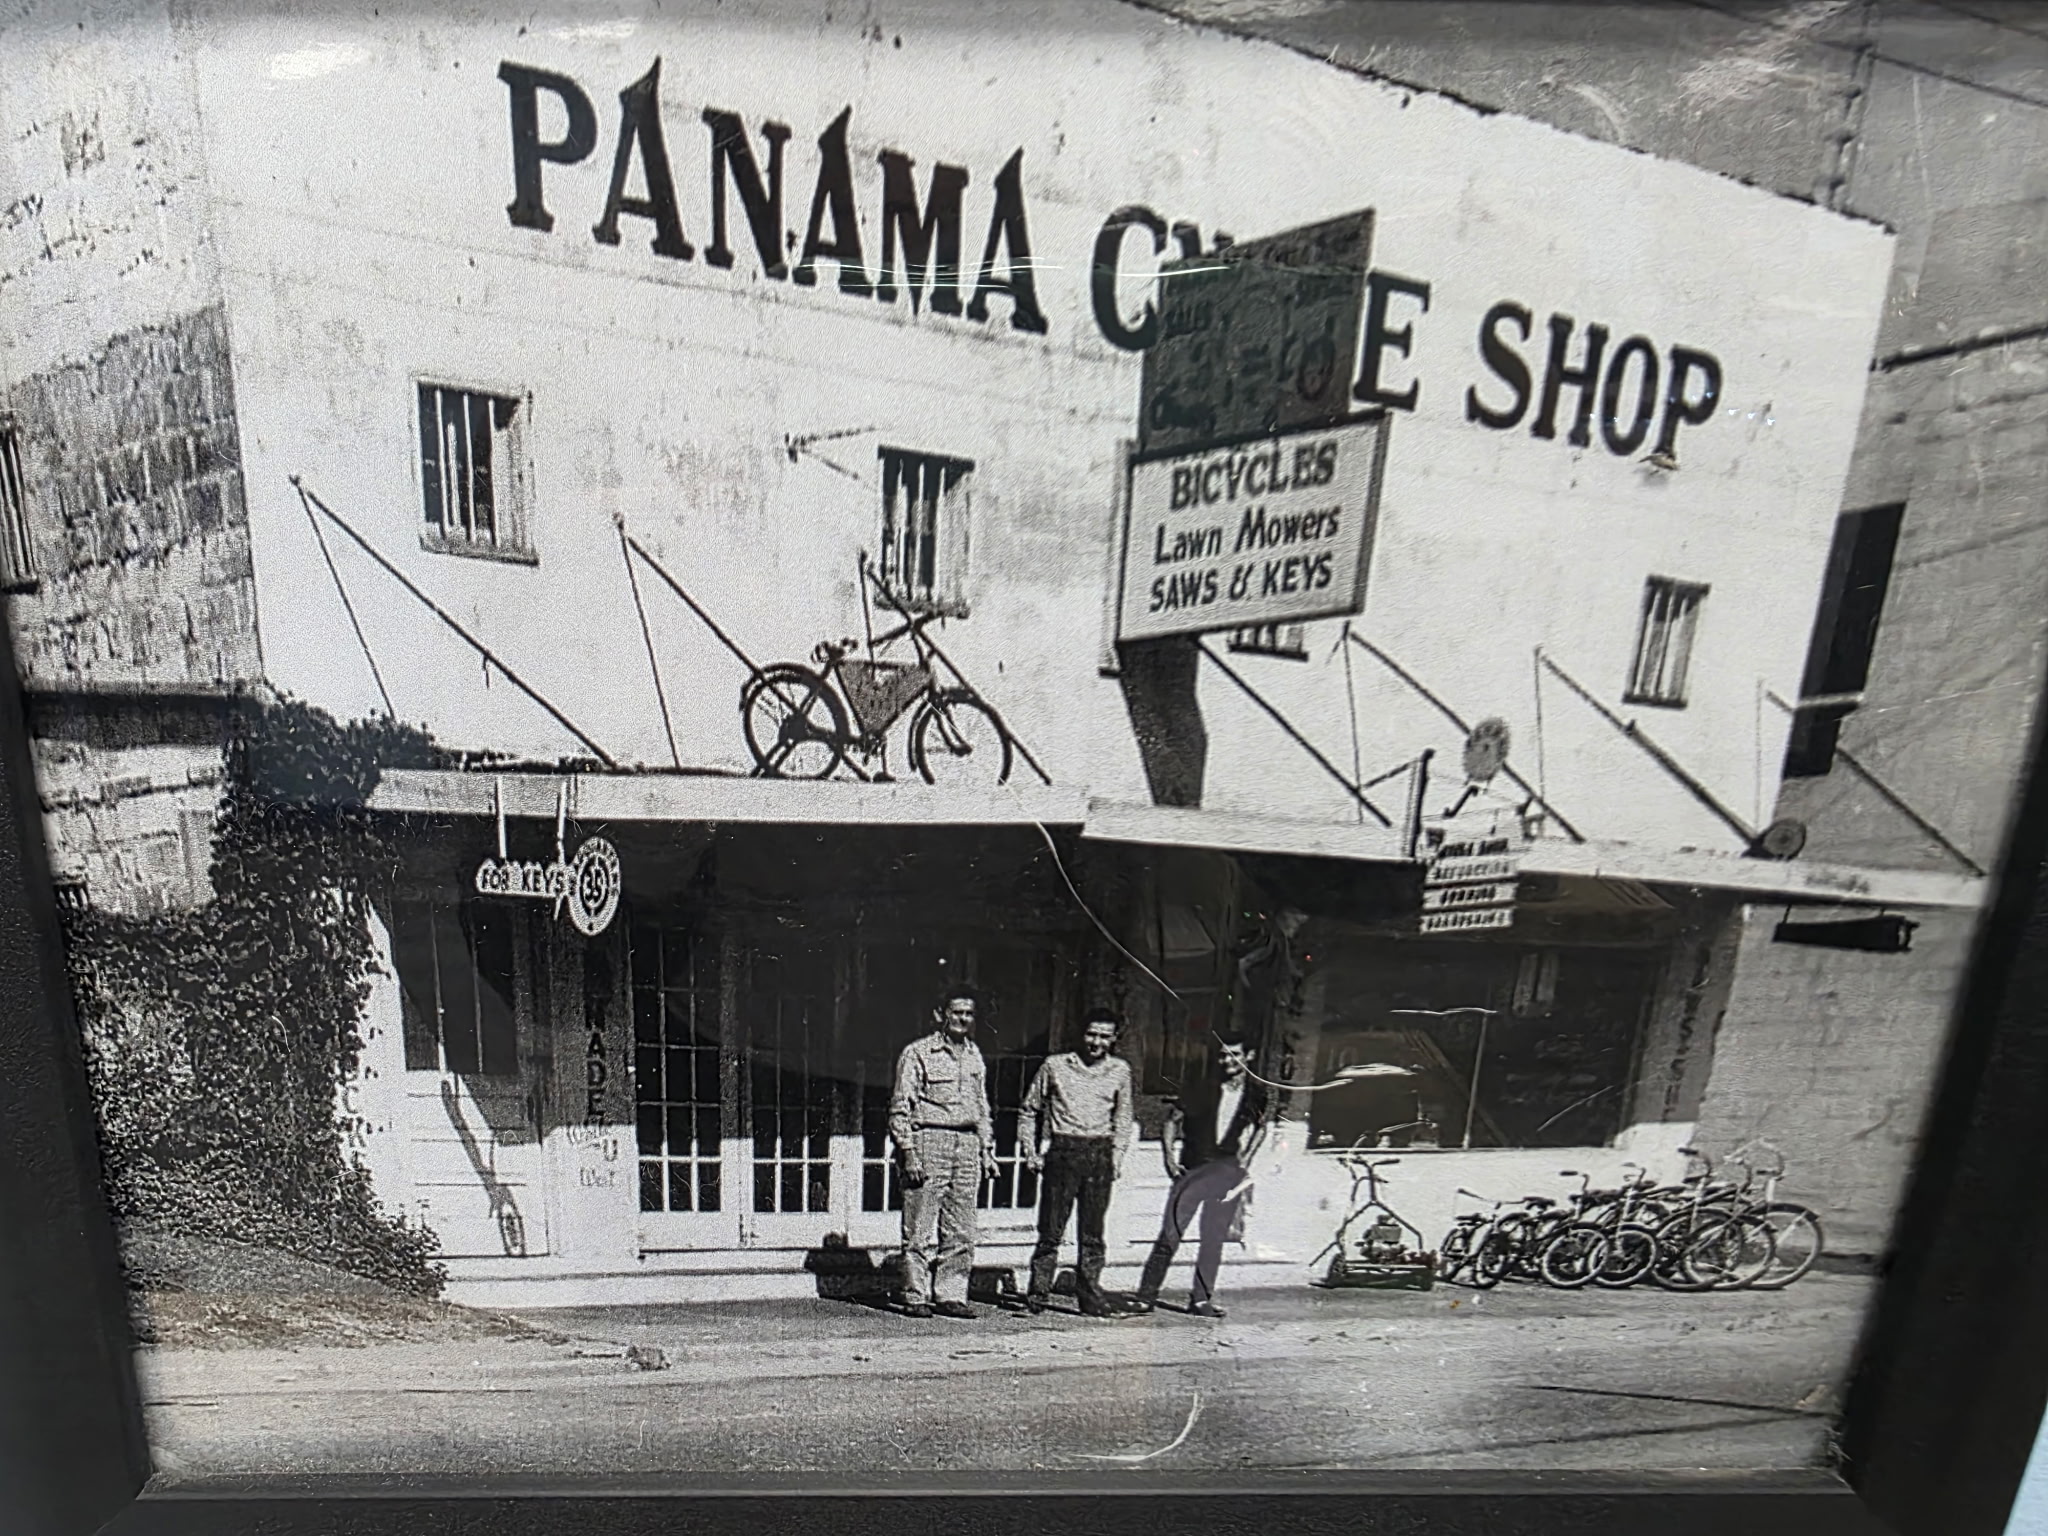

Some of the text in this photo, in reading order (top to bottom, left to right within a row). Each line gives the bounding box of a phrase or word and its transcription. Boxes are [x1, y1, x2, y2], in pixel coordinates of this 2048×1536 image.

[498, 55, 1047, 334] PANAMA
[1466, 300, 1722, 460] SHOP
[1171, 441, 1338, 511] BICYCLES
[1154, 506, 1341, 564] Lawn Mowers
[1150, 551, 1332, 612] SAWS & KEYS
[523, 868, 565, 894] KEYS
